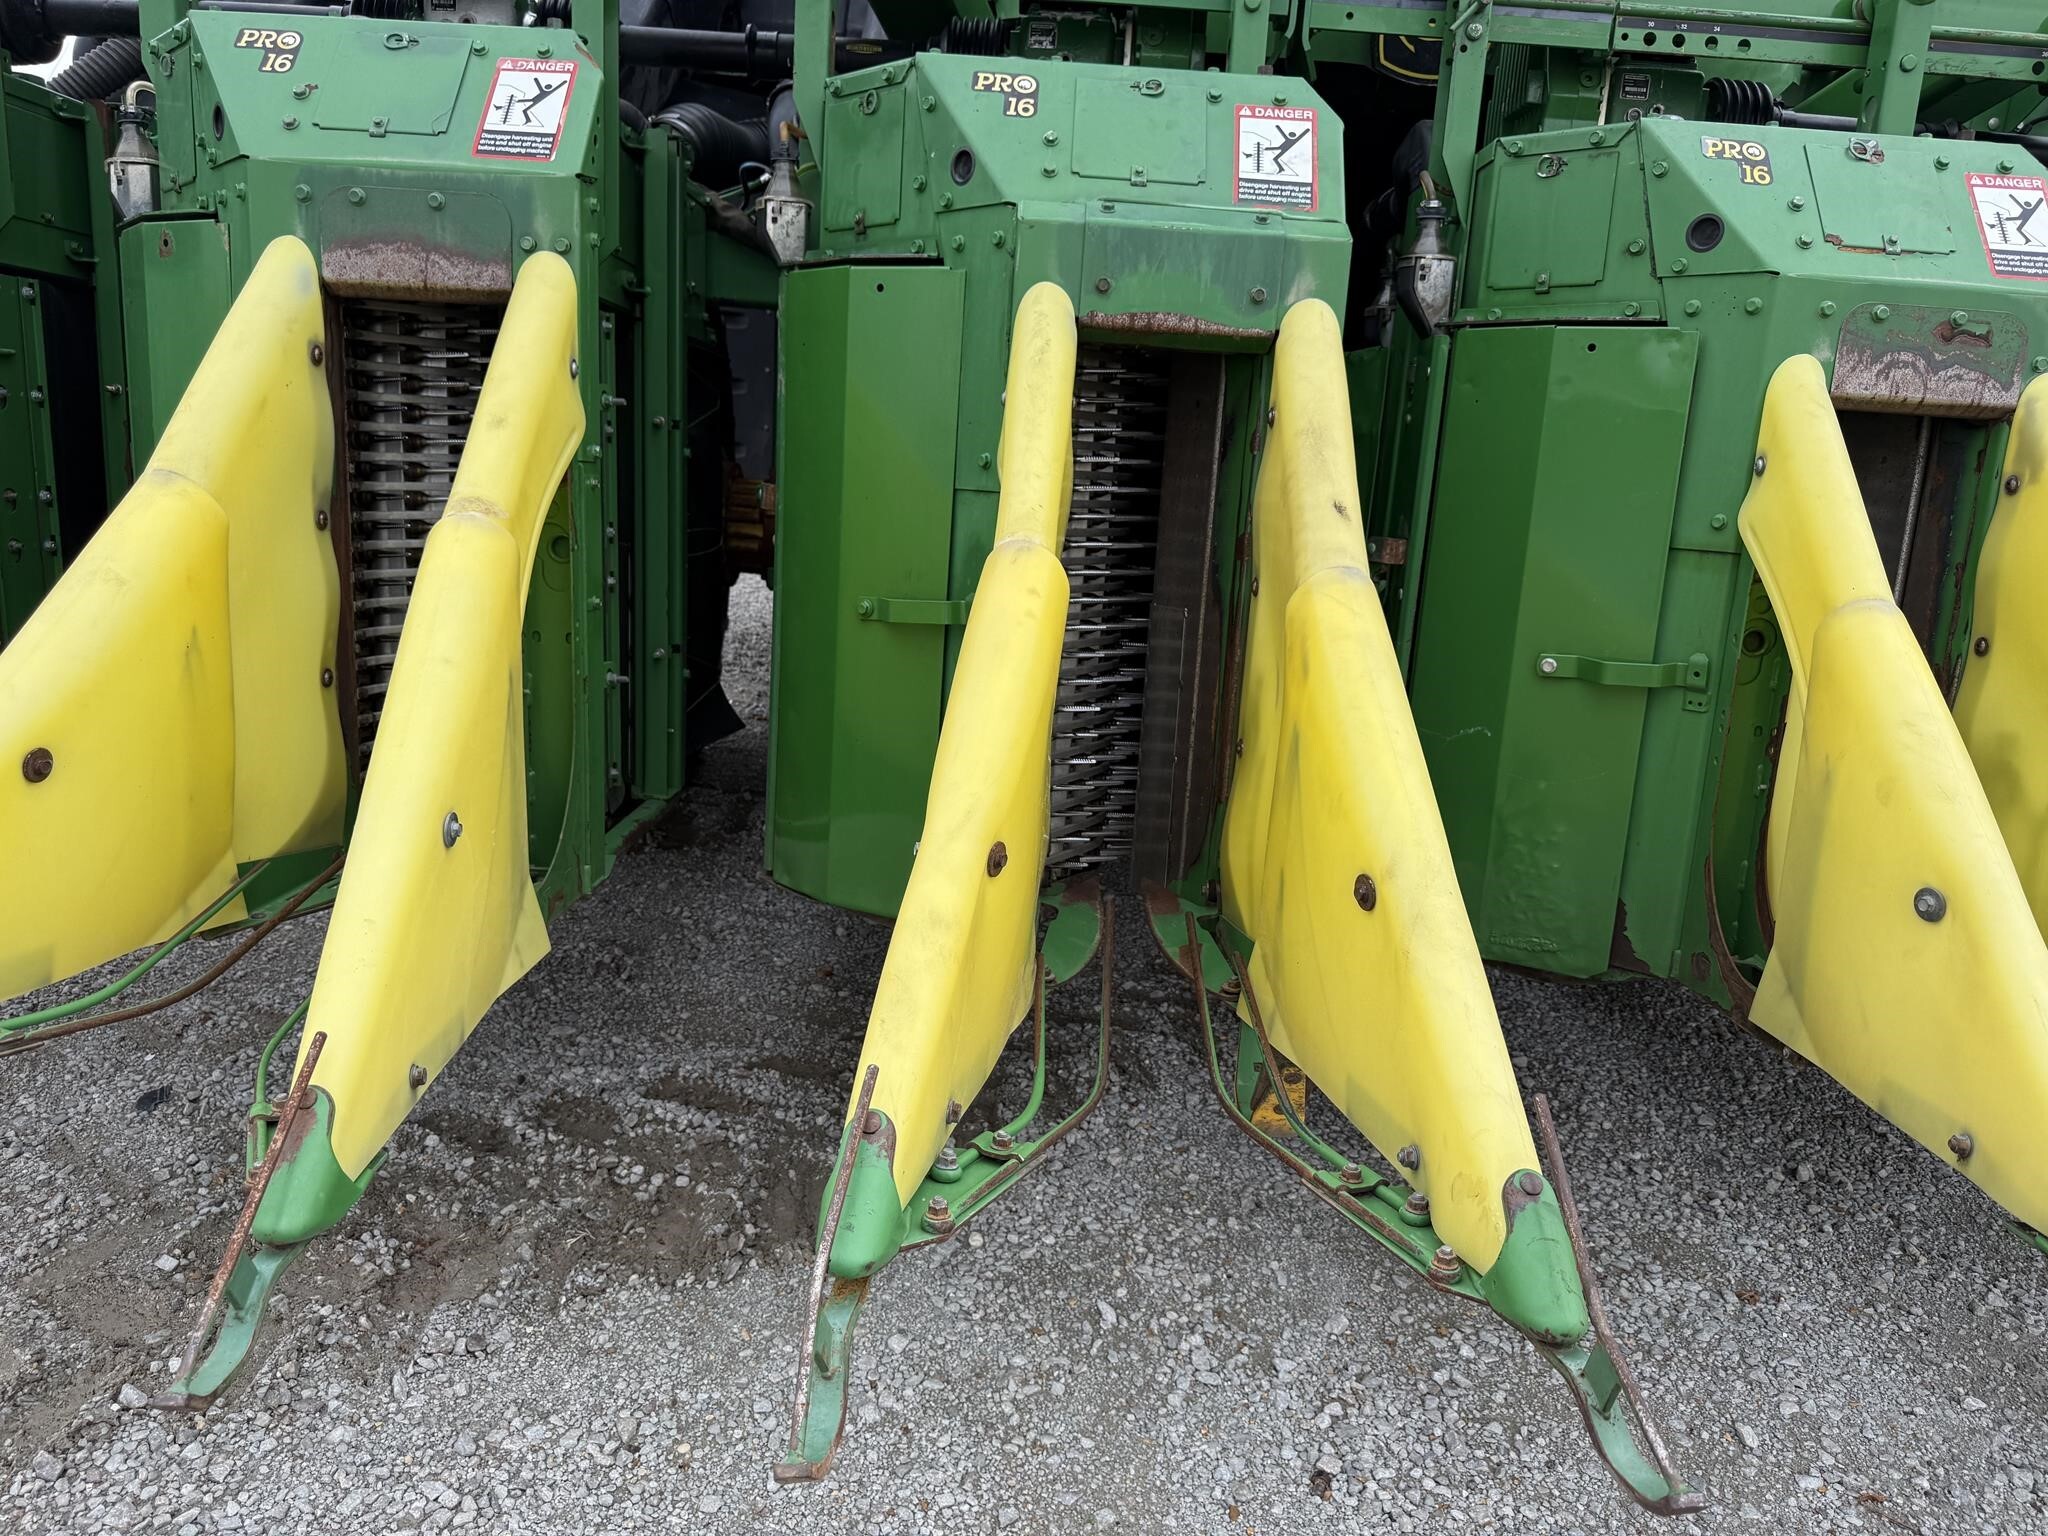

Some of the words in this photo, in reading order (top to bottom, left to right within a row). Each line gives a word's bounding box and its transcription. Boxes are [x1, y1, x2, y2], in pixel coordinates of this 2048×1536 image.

[236, 29, 301, 50] PRO
[262, 53, 294, 72] 16
[516, 60, 575, 72] DANGER
[974, 72, 1037, 94] PRO
[1006, 97, 1035, 117] 16
[1254, 107, 1313, 120] DANGER
[481, 132, 512, 141] Disengage
[511, 134, 542, 143] harvesting
[495, 147, 527, 155] unclogging
[1705, 139, 1766, 161] PRO
[1743, 164, 1771, 185] 16
[1239, 181, 1269, 190] Disengage
[1269, 183, 1300, 192] harvesting
[1984, 176, 2043, 189] DANGER
[1256, 195, 1287, 204] unclogging
